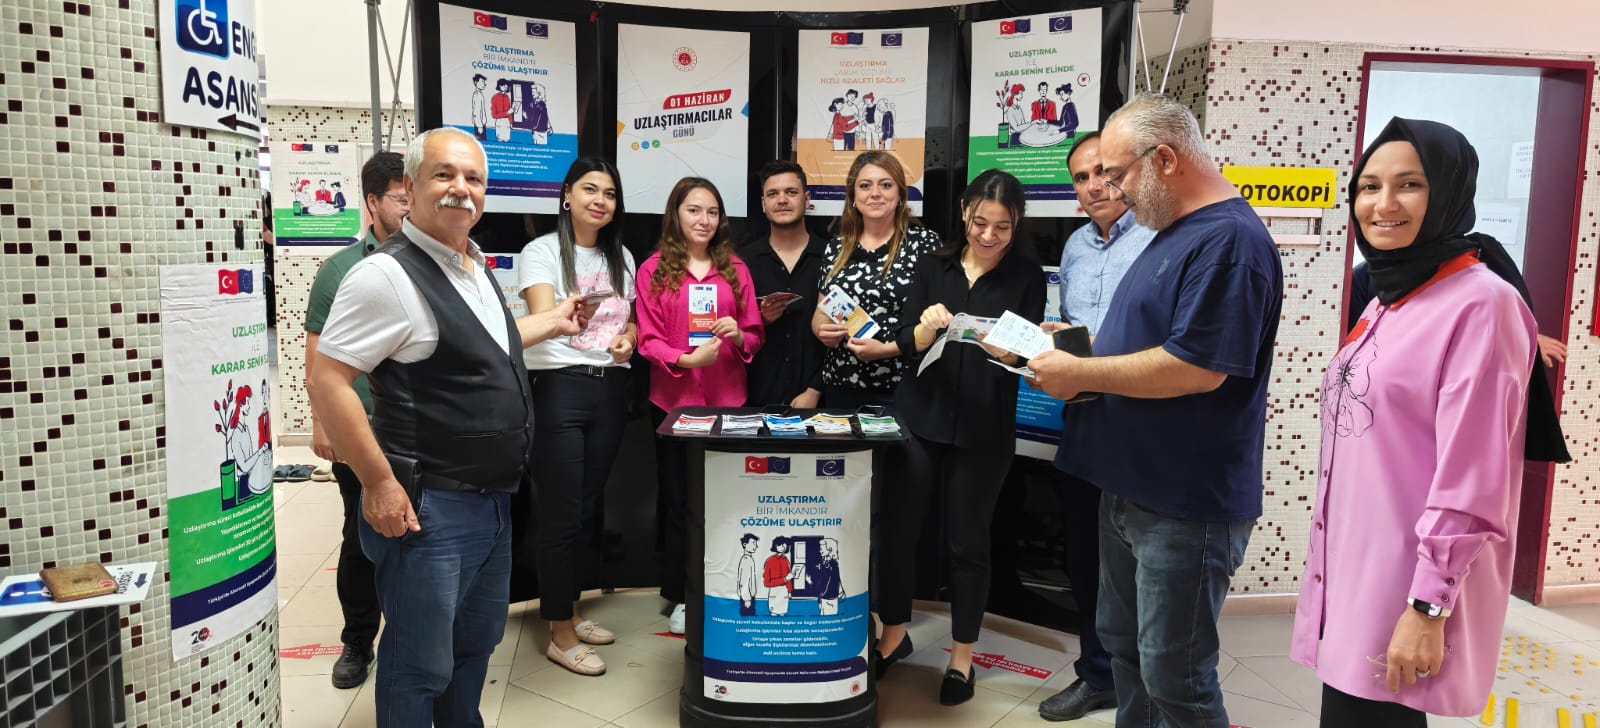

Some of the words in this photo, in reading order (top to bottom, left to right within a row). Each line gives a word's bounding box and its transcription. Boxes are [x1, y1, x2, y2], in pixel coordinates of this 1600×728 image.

[484, 44, 535, 57] UZLAŞTIRMA
[1009, 48, 1057, 58] UZLAŞTIRMA
[472, 61, 506, 71] ÇÖZÜME
[507, 65, 549, 76] ULAŞTIRIR
[994, 69, 1019, 77] KARAR
[1020, 66, 1043, 75] SENİN
[1045, 64, 1075, 73] ELİNDE
[841, 76, 875, 84] ADALETİ
[183, 66, 260, 119] ASANS
[670, 97, 681, 108] 01
[684, 92, 725, 106] HAZİRAN
[634, 107, 733, 131] UZLAŞTIRMACILAR
[672, 127, 695, 138] GÜNÜ
[1234, 182, 1330, 202] OTOKOPİ
[211, 360, 246, 376] KARAR
[758, 495, 826, 505] UZLAŞTIRMA
[756, 505, 774, 515] BİR
[776, 505, 828, 515] İMKANDIR
[740, 516, 786, 527] ÇÖZÜME
[788, 518, 842, 528] ULAŞTIRIR
